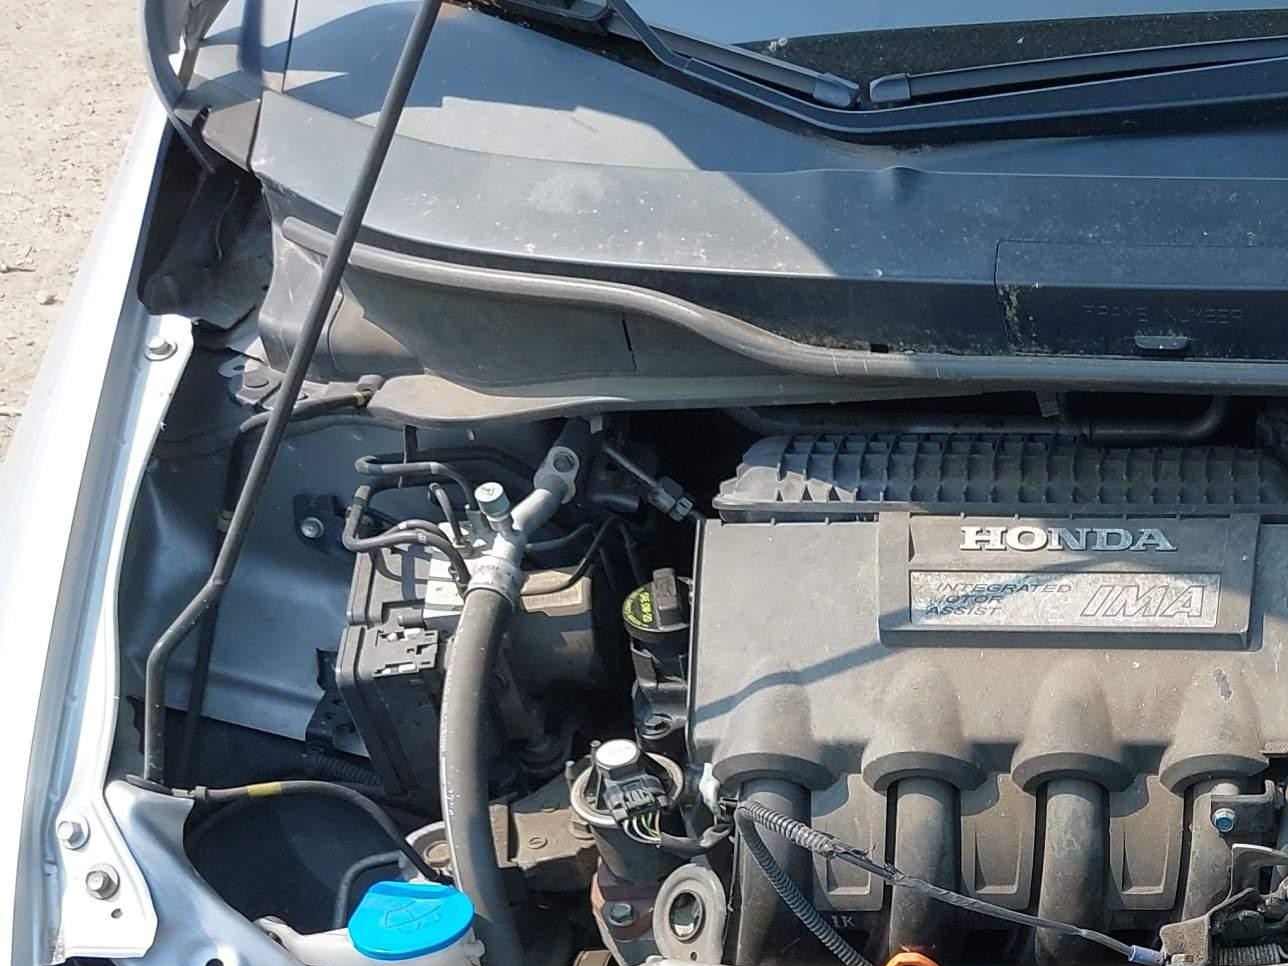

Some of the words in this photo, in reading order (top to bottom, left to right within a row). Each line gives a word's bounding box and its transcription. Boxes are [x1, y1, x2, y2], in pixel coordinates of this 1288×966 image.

[960, 525, 1177, 552] HONDA
[935, 583, 1073, 593] INTEGRATED
[929, 595, 1005, 604] MOTOR
[1080, 584, 1206, 617] IMA
[925, 606, 1003, 616] ASSIST
